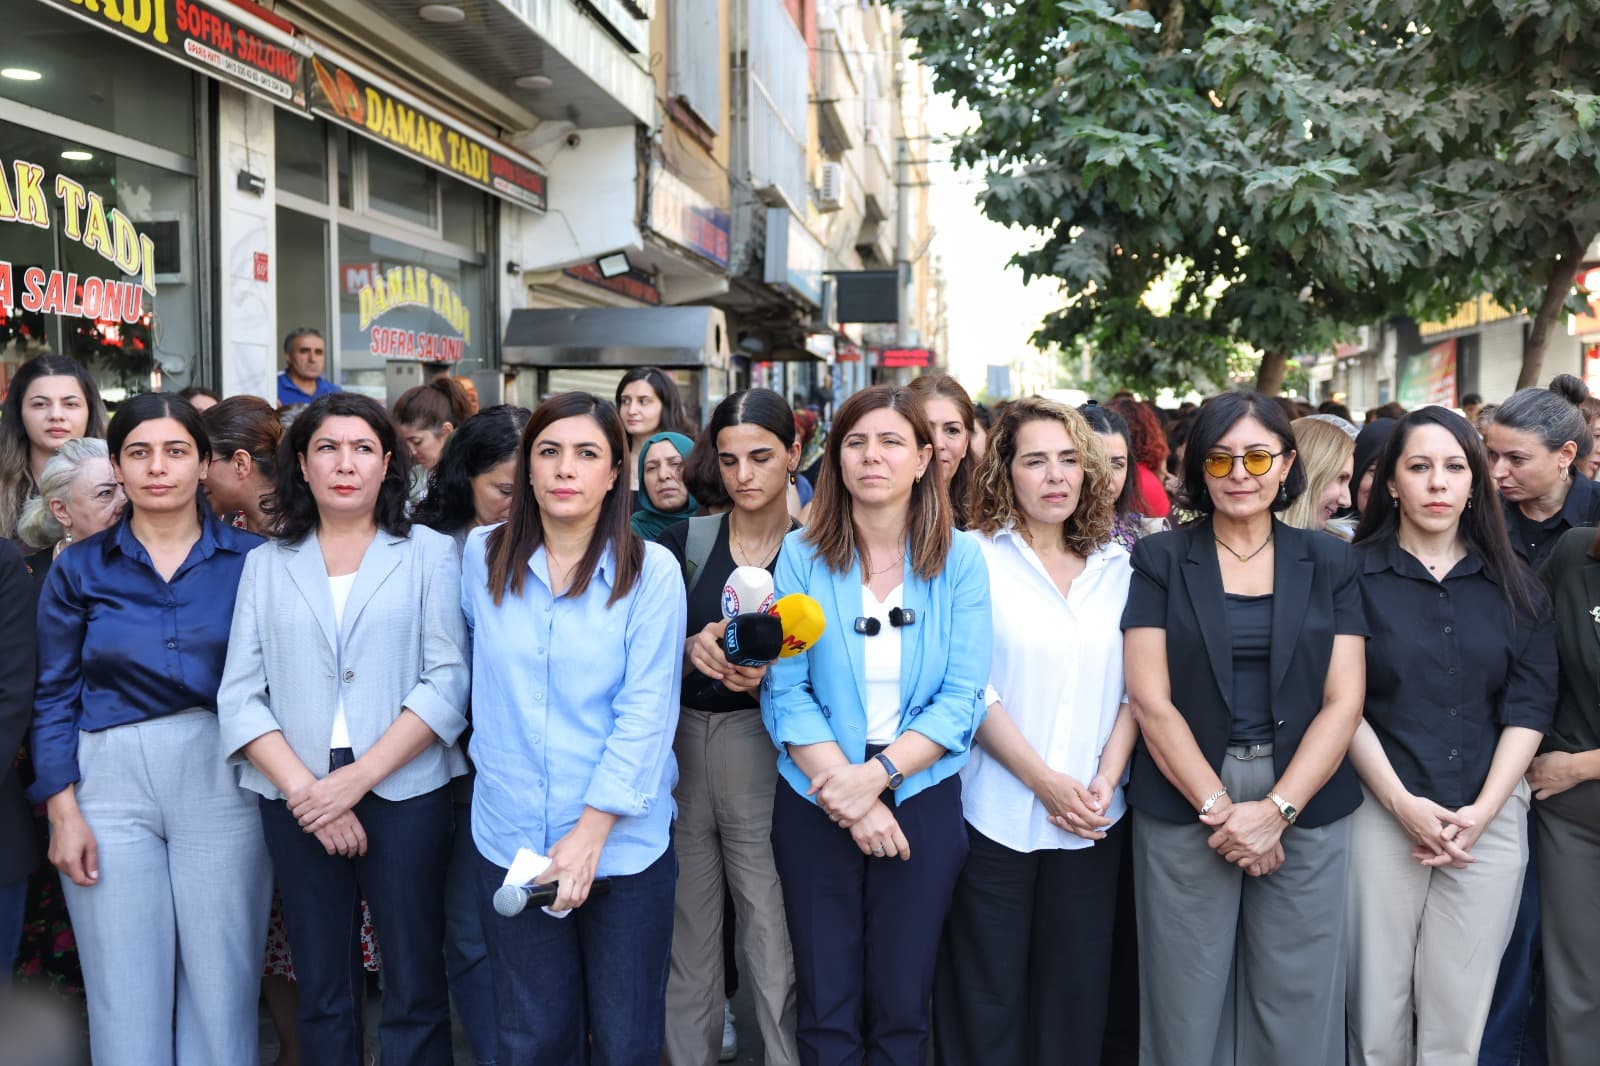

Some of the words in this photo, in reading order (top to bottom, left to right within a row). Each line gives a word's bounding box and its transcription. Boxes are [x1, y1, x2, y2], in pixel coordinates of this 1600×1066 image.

[175, 0, 234, 53] SOFRA
[236, 28, 298, 82] SALONU
[365, 87, 445, 164] DAMAK
[448, 131, 490, 183] TADI
[56, 174, 156, 296] TADI
[22, 267, 143, 324] SALONU
[359, 266, 429, 331] DAMAK
[430, 273, 470, 346] TADI
[370, 325, 413, 356] SOFRA
[417, 332, 464, 362] SALONU
